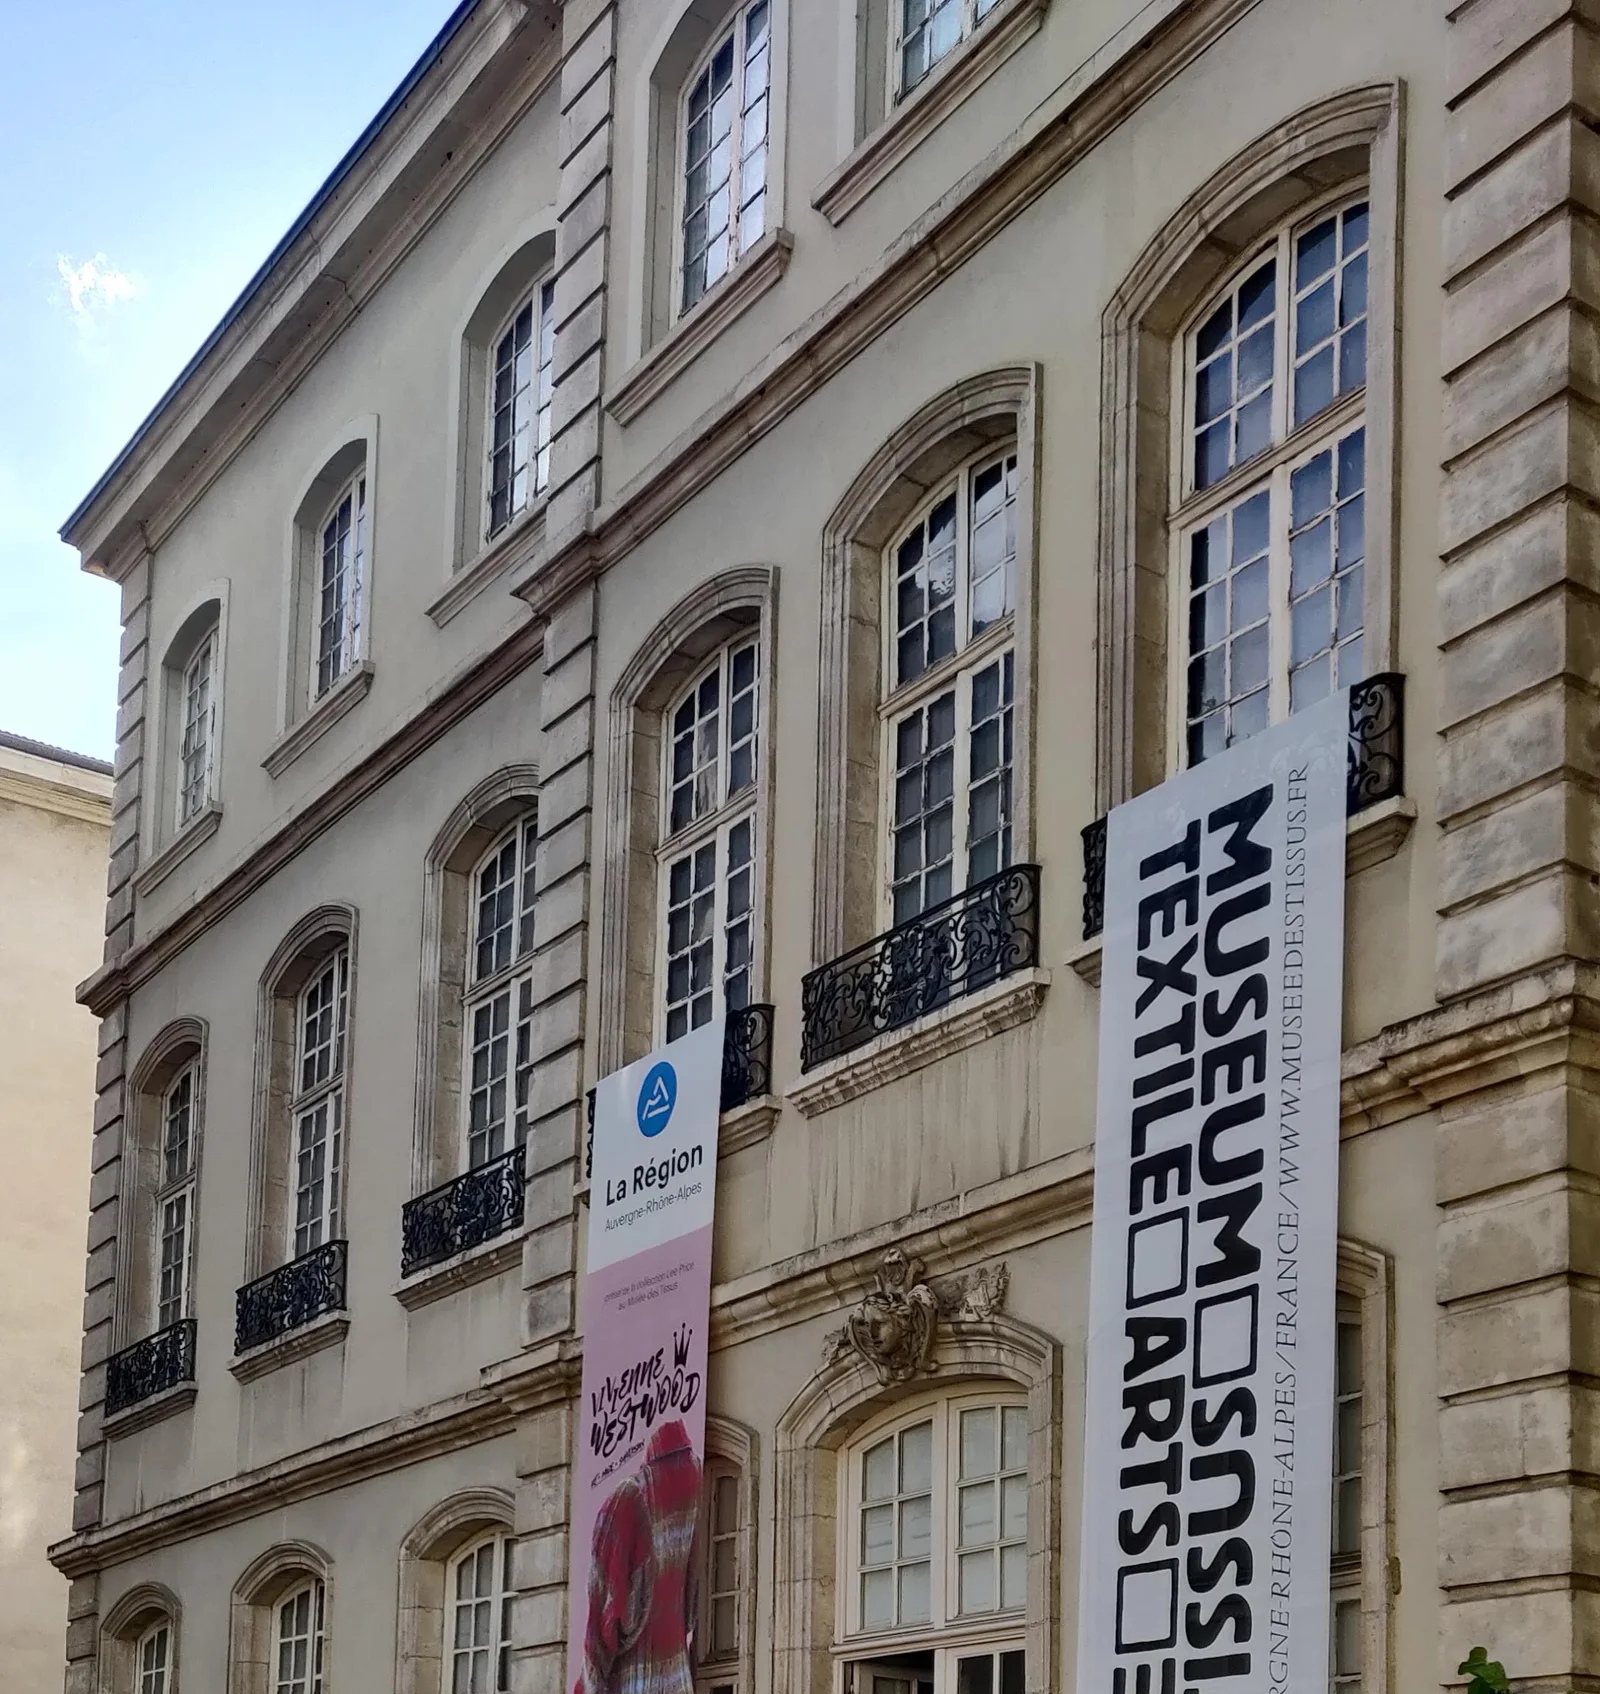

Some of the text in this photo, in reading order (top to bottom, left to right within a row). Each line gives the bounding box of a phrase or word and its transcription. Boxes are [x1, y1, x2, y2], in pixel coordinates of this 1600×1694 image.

[1129, 818, 1202, 1216] TEXTILE
[1195, 783, 1274, 1288] MUSEUM
[604, 1181, 703, 1233] Auvergne-Rhône-Alpes
[605, 1144, 703, 1207] La Région
[590, 1367, 701, 1458] WESTWOOD
[591, 1346, 666, 1418] VIVIENNE
[1117, 1316, 1187, 1556] ARTS
